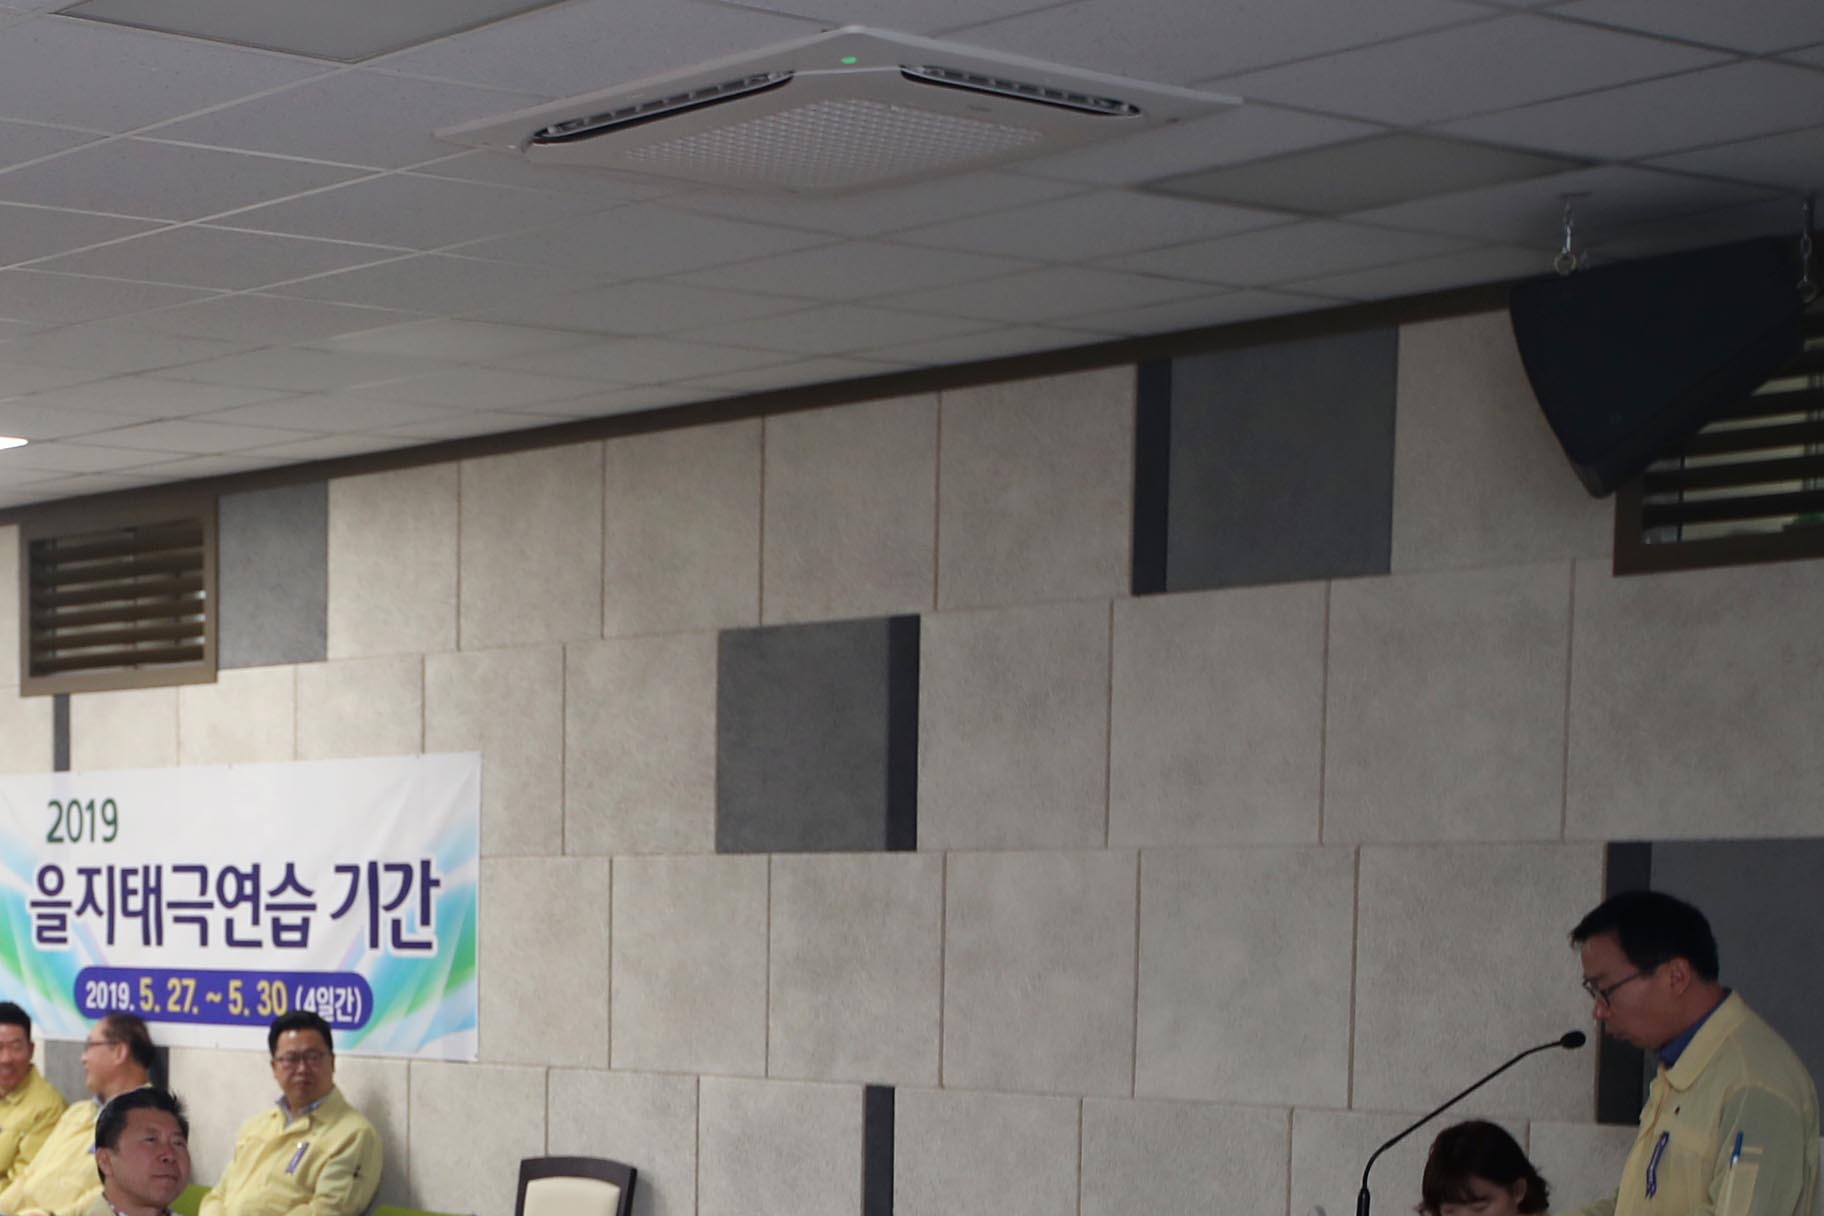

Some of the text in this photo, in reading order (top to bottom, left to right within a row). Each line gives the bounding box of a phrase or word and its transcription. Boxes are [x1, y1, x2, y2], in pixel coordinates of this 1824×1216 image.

[45, 797, 120, 844] 2019
[29, 858, 443, 950] 을지태극연습 기간
[85, 980, 135, 1012] 2019.
[139, 976, 161, 1013] 5.
[166, 977, 199, 1014] 27.
[228, 979, 251, 1016] 5.
[256, 979, 288, 1016] 30
[294, 984, 363, 1023] (4일간)
